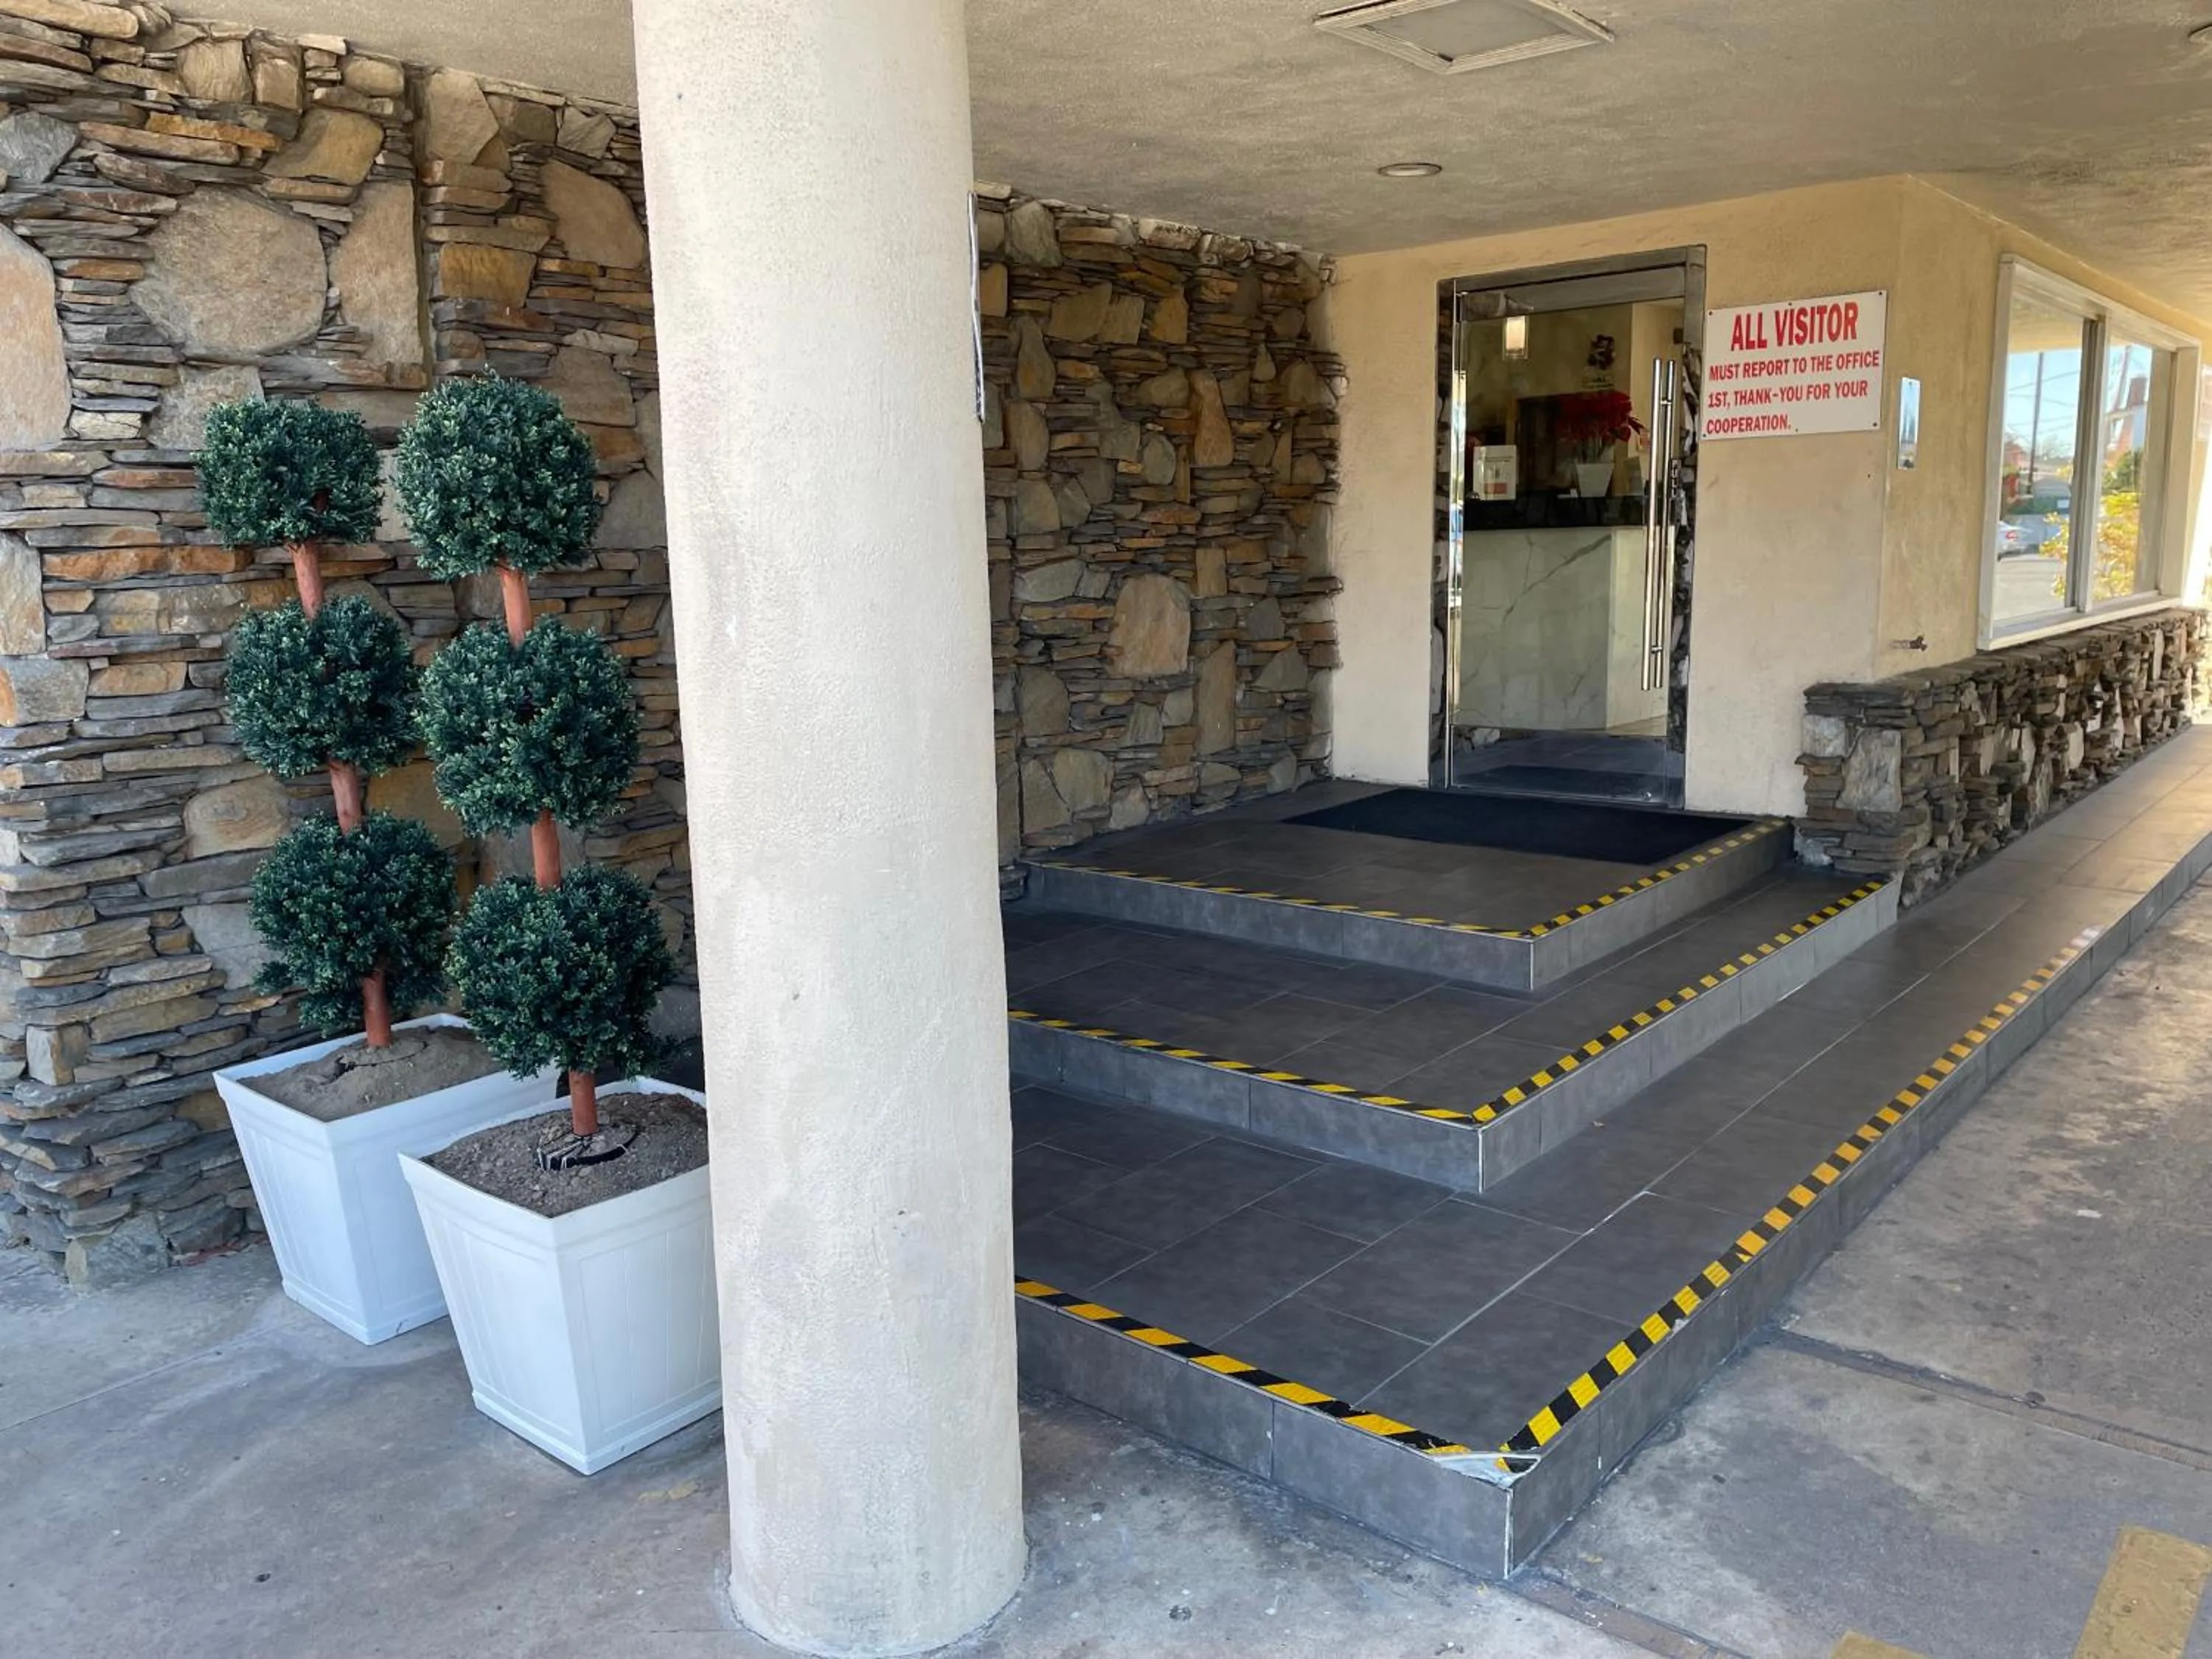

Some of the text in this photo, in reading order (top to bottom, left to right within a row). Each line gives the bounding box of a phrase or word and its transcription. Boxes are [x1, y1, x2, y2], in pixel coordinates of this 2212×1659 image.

[1731, 302, 1859, 351] ALL VISITOR
[1709, 350, 1879, 381] MUST REPORT TO THE OFFICE
[1708, 380, 1868, 410] 1ST, THANK-YOU FOR YOUR
[1706, 414, 1791, 434] COOPERATION.
